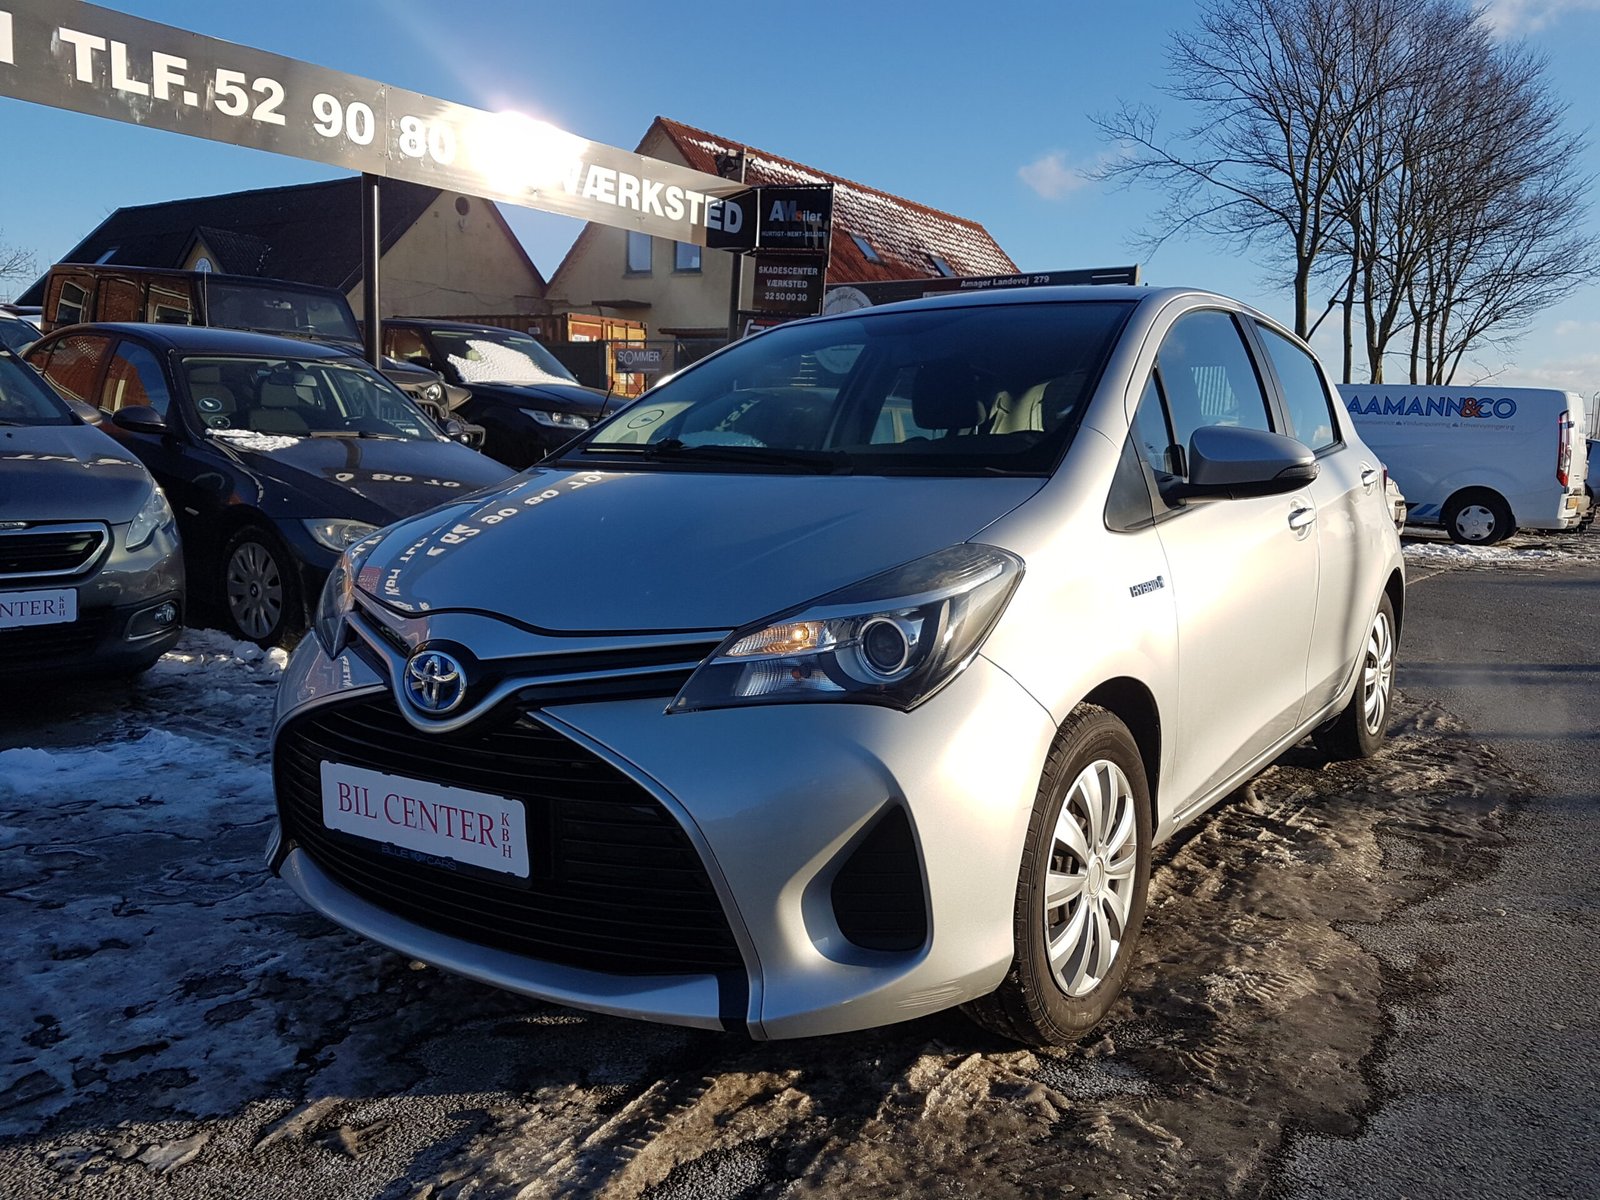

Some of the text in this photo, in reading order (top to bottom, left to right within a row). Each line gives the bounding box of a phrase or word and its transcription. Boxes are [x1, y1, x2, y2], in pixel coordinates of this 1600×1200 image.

[58, 26, 199, 107] TLF.
[213, 68, 287, 126] 52
[311, 92, 375, 146] 90
[399, 115, 456, 165] 80
[758, 266, 818, 275] SKADESCENTER
[766, 279, 808, 288] VÆRKSTED
[960, 275, 1050, 288] Amager Landevej 279
[764, 291, 808, 302] 32 50 00 30
[617, 350, 660, 365] SOMMER
[336, 782, 498, 849] BIL CENTER
